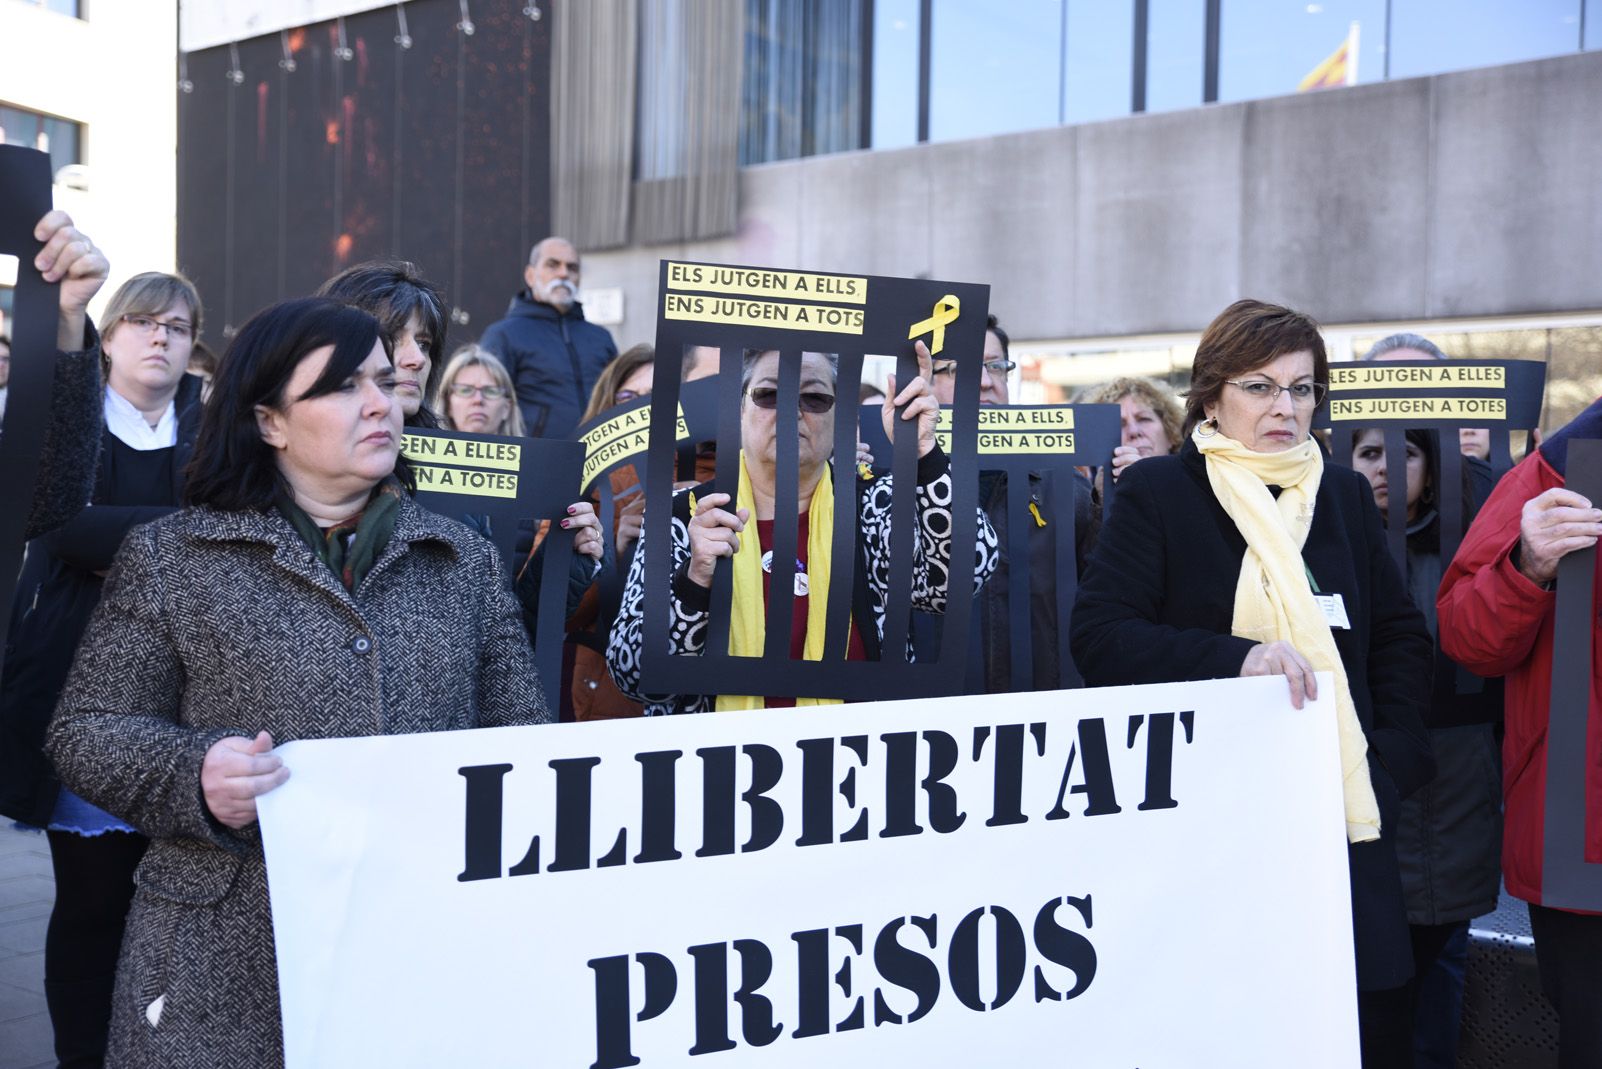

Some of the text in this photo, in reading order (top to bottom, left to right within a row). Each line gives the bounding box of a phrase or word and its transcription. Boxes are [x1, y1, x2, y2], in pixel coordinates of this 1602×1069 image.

[672, 266, 703, 283] ELS
[710, 269, 787, 290] JUTGEN
[794, 276, 808, 291] A
[667, 296, 863, 327] ENS JUTGEN A TOTS
[1363, 368, 1432, 383] JUTGEN
[1440, 368, 1452, 381] A
[1458, 368, 1502, 381] ELLES
[1015, 411, 1026, 423] A
[1332, 400, 1505, 414] ENS JUTGEN A TOTES
[625, 415, 636, 427] A
[443, 440, 458, 456] A
[465, 442, 517, 461] ELLES
[1018, 435, 1030, 447] A
[1034, 435, 1073, 448] TOTS
[584, 434, 646, 476] JUTGEN A
[440, 470, 454, 485] A
[460, 471, 516, 490] TOTES
[457, 710, 1195, 882] LLIBERTAT
[587, 894, 1098, 1069] PRESOS
